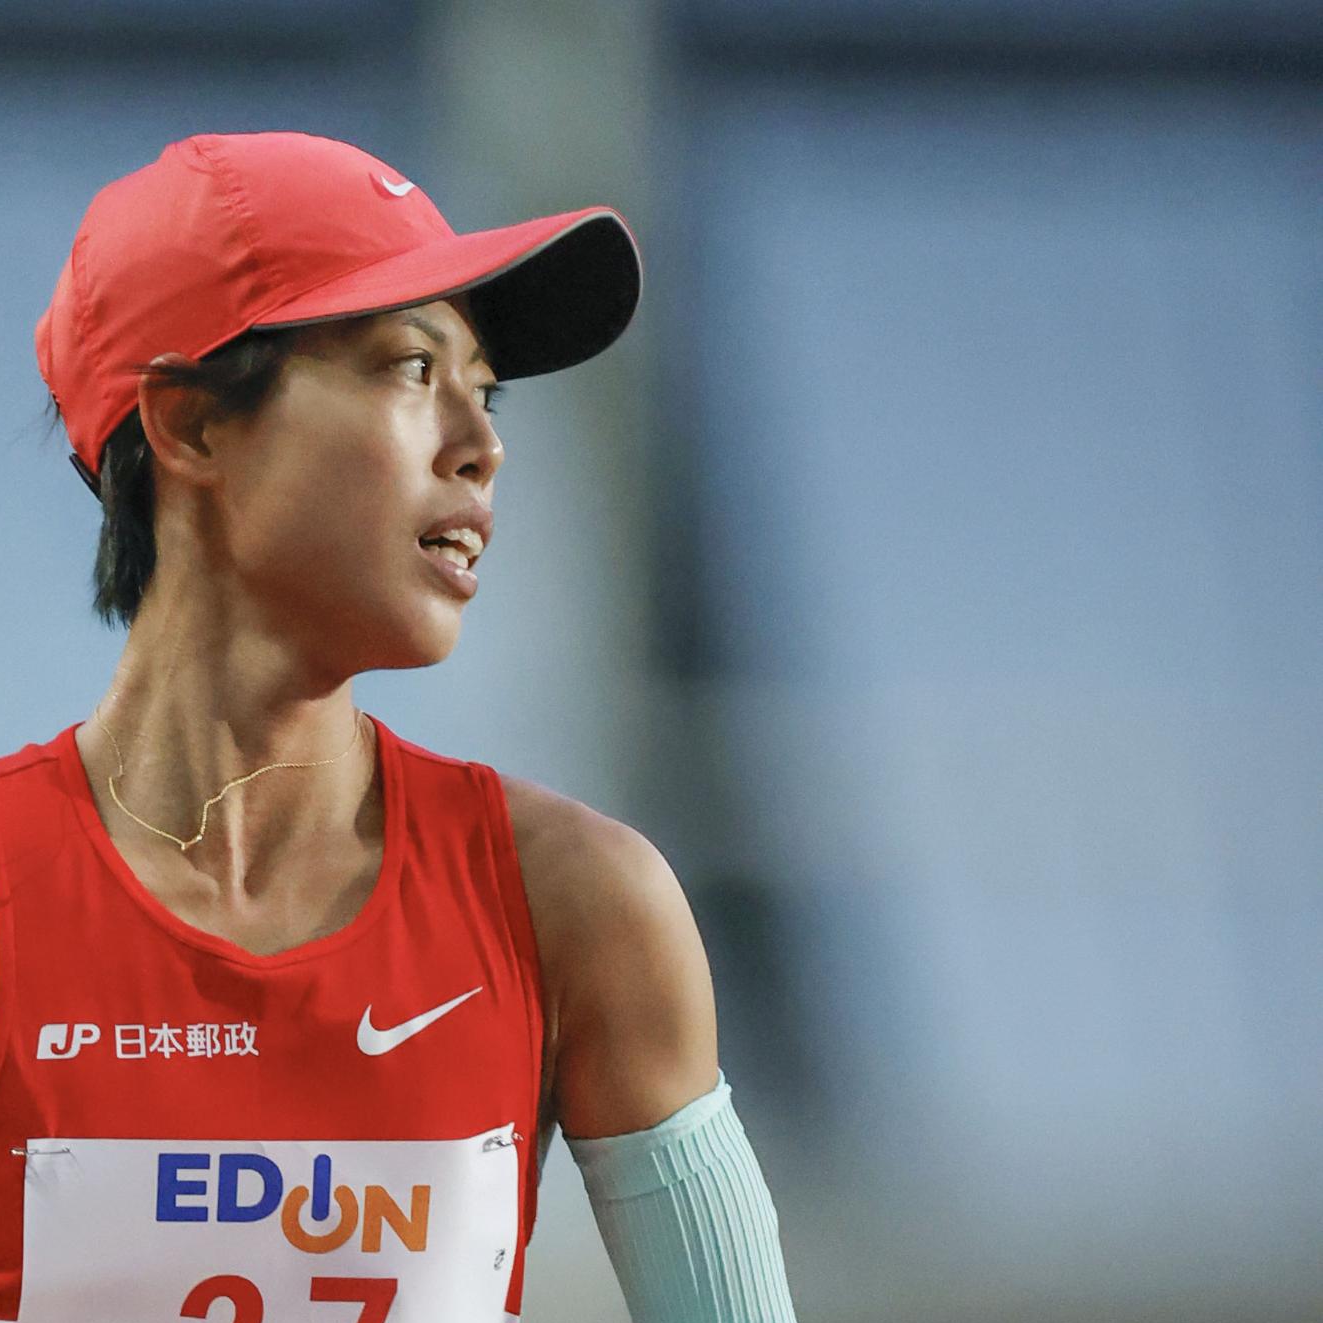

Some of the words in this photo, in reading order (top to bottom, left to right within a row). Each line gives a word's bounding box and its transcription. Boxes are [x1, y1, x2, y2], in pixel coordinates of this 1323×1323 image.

[36, 1023, 102, 1060] JP
[114, 1021, 260, 1060] 日本郵政
[156, 1153, 431, 1254] EDION
